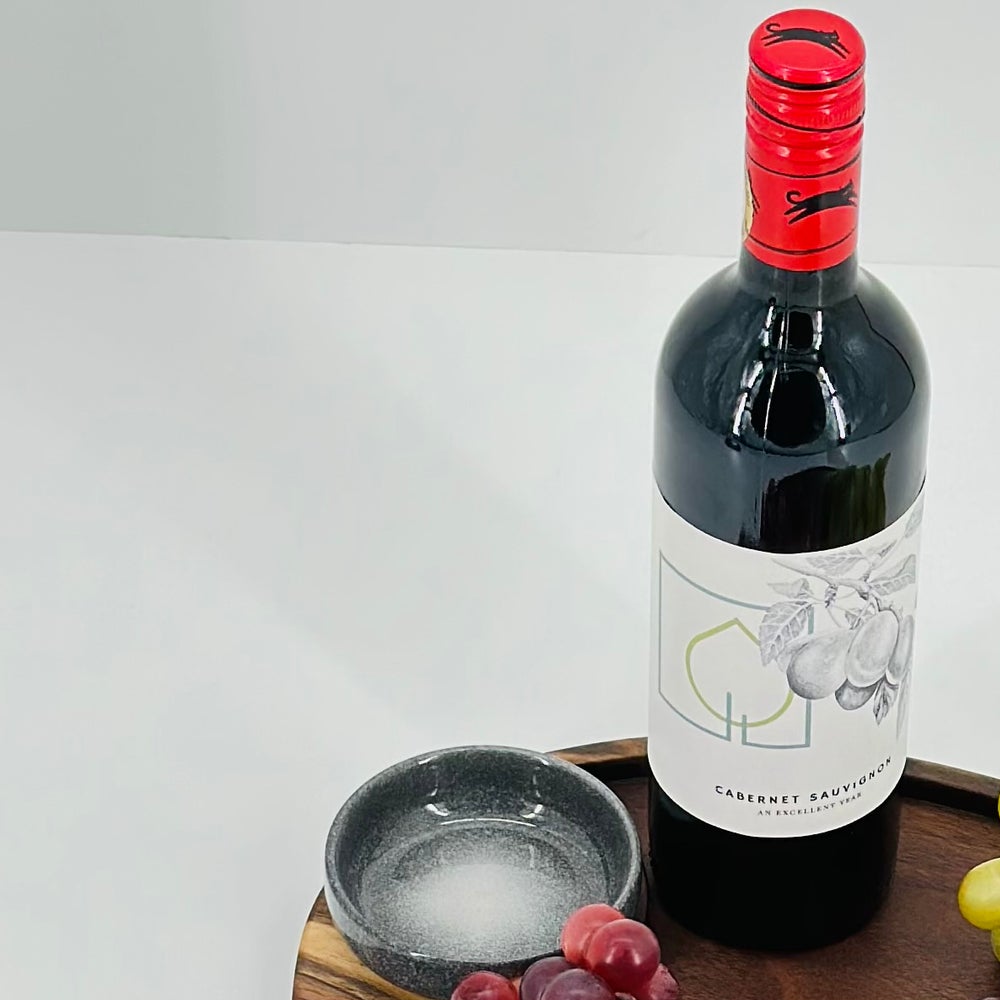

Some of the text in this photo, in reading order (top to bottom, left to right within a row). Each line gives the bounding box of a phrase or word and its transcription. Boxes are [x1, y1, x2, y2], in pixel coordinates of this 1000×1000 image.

[716, 756, 892, 804] CABERNET SAUVIGNON
[776, 803, 836, 816] EXCELLENT
[840, 792, 862, 807] YEAR
